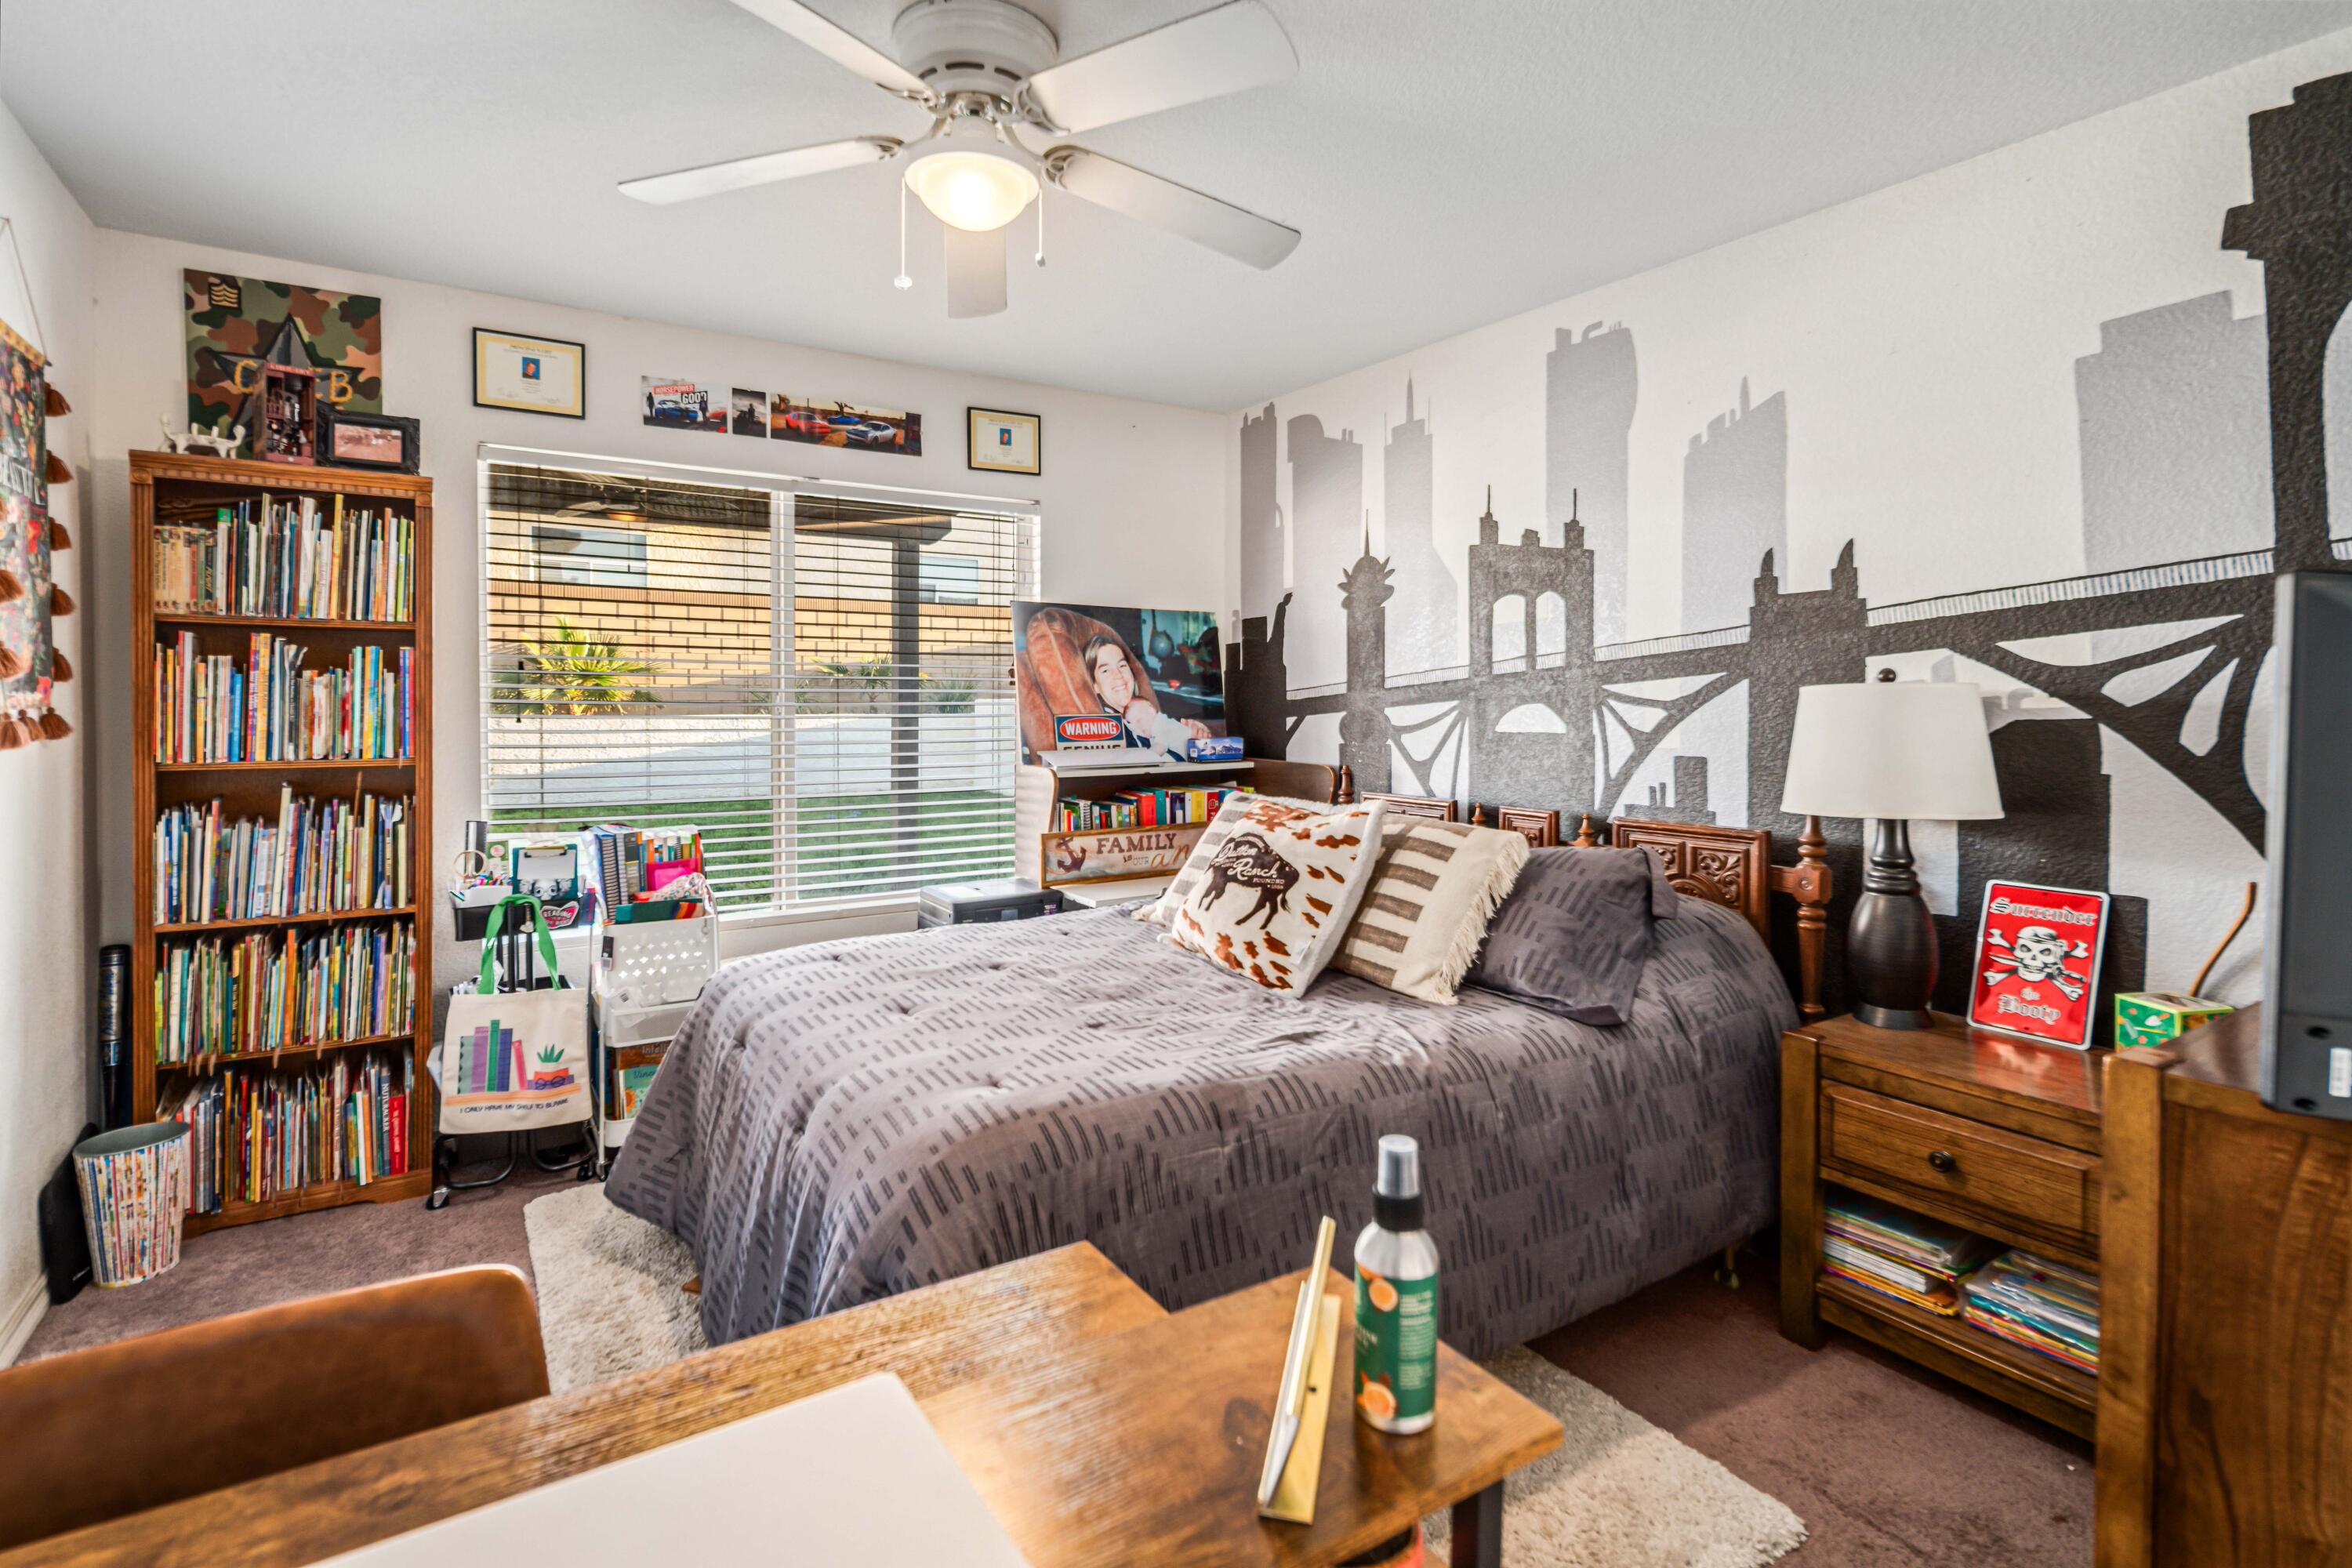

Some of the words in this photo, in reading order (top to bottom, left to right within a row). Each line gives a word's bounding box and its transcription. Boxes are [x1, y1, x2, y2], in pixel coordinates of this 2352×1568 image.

[655, 384, 694, 393] HORSEPOWER
[1065, 721, 1117, 735] WARNING
[1096, 833, 1178, 855] FAMILY
[1133, 856, 1149, 866] OUR
[1227, 858, 1279, 880] Ranch
[1989, 897, 2098, 927] Surrender
[2020, 986, 2041, 1001] the
[1998, 993, 2061, 1025] Booty
[464, 1105, 483, 1114] ONLY
[545, 1098, 568, 1108] BLAME
